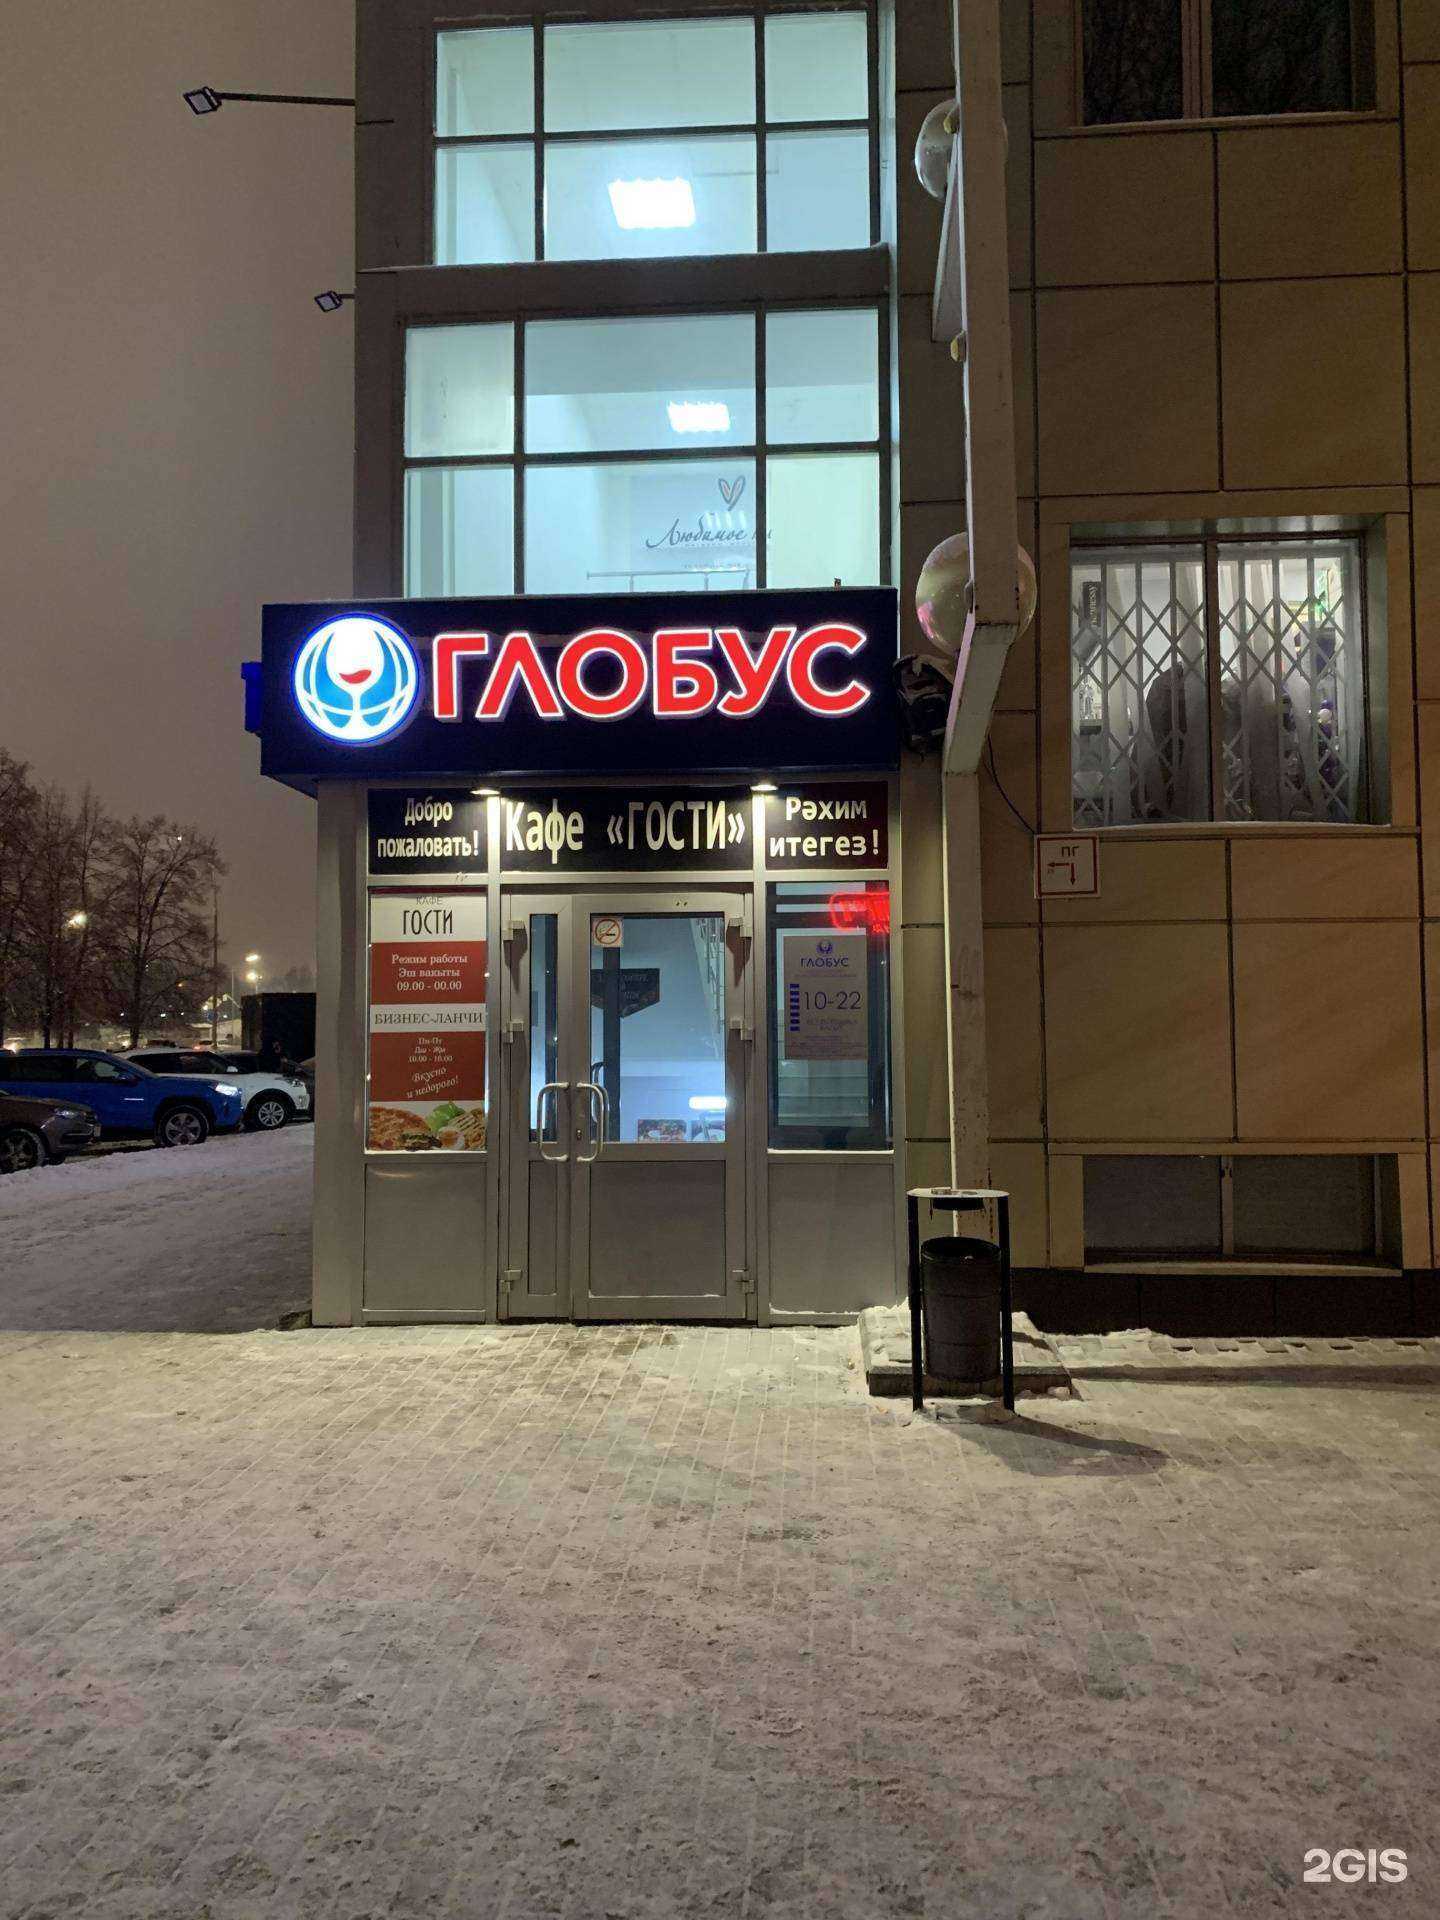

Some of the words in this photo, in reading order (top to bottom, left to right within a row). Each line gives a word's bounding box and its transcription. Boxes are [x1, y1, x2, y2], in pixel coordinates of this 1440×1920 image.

[646, 514, 748, 548] Любимое
[432, 622, 871, 718] ГЛОБУС
[404, 796, 453, 827] Добро
[785, 797, 867, 821] Рәхим
[377, 830, 479, 857] пожаловать!
[505, 799, 584, 864] Кафе
[607, 800, 746, 850] «ГОСТИ»
[1061, 846, 1079, 856] ПГ
[403, 909, 453, 935] ГОСТИ
[391, 954, 427, 964] Режим
[430, 953, 468, 965] работы
[801, 957, 849, 967] ГЛОБУС
[805, 991, 861, 1010] 10-22
[374, 1013, 483, 1025] БИЗНЕС-ЛАНЧИ
